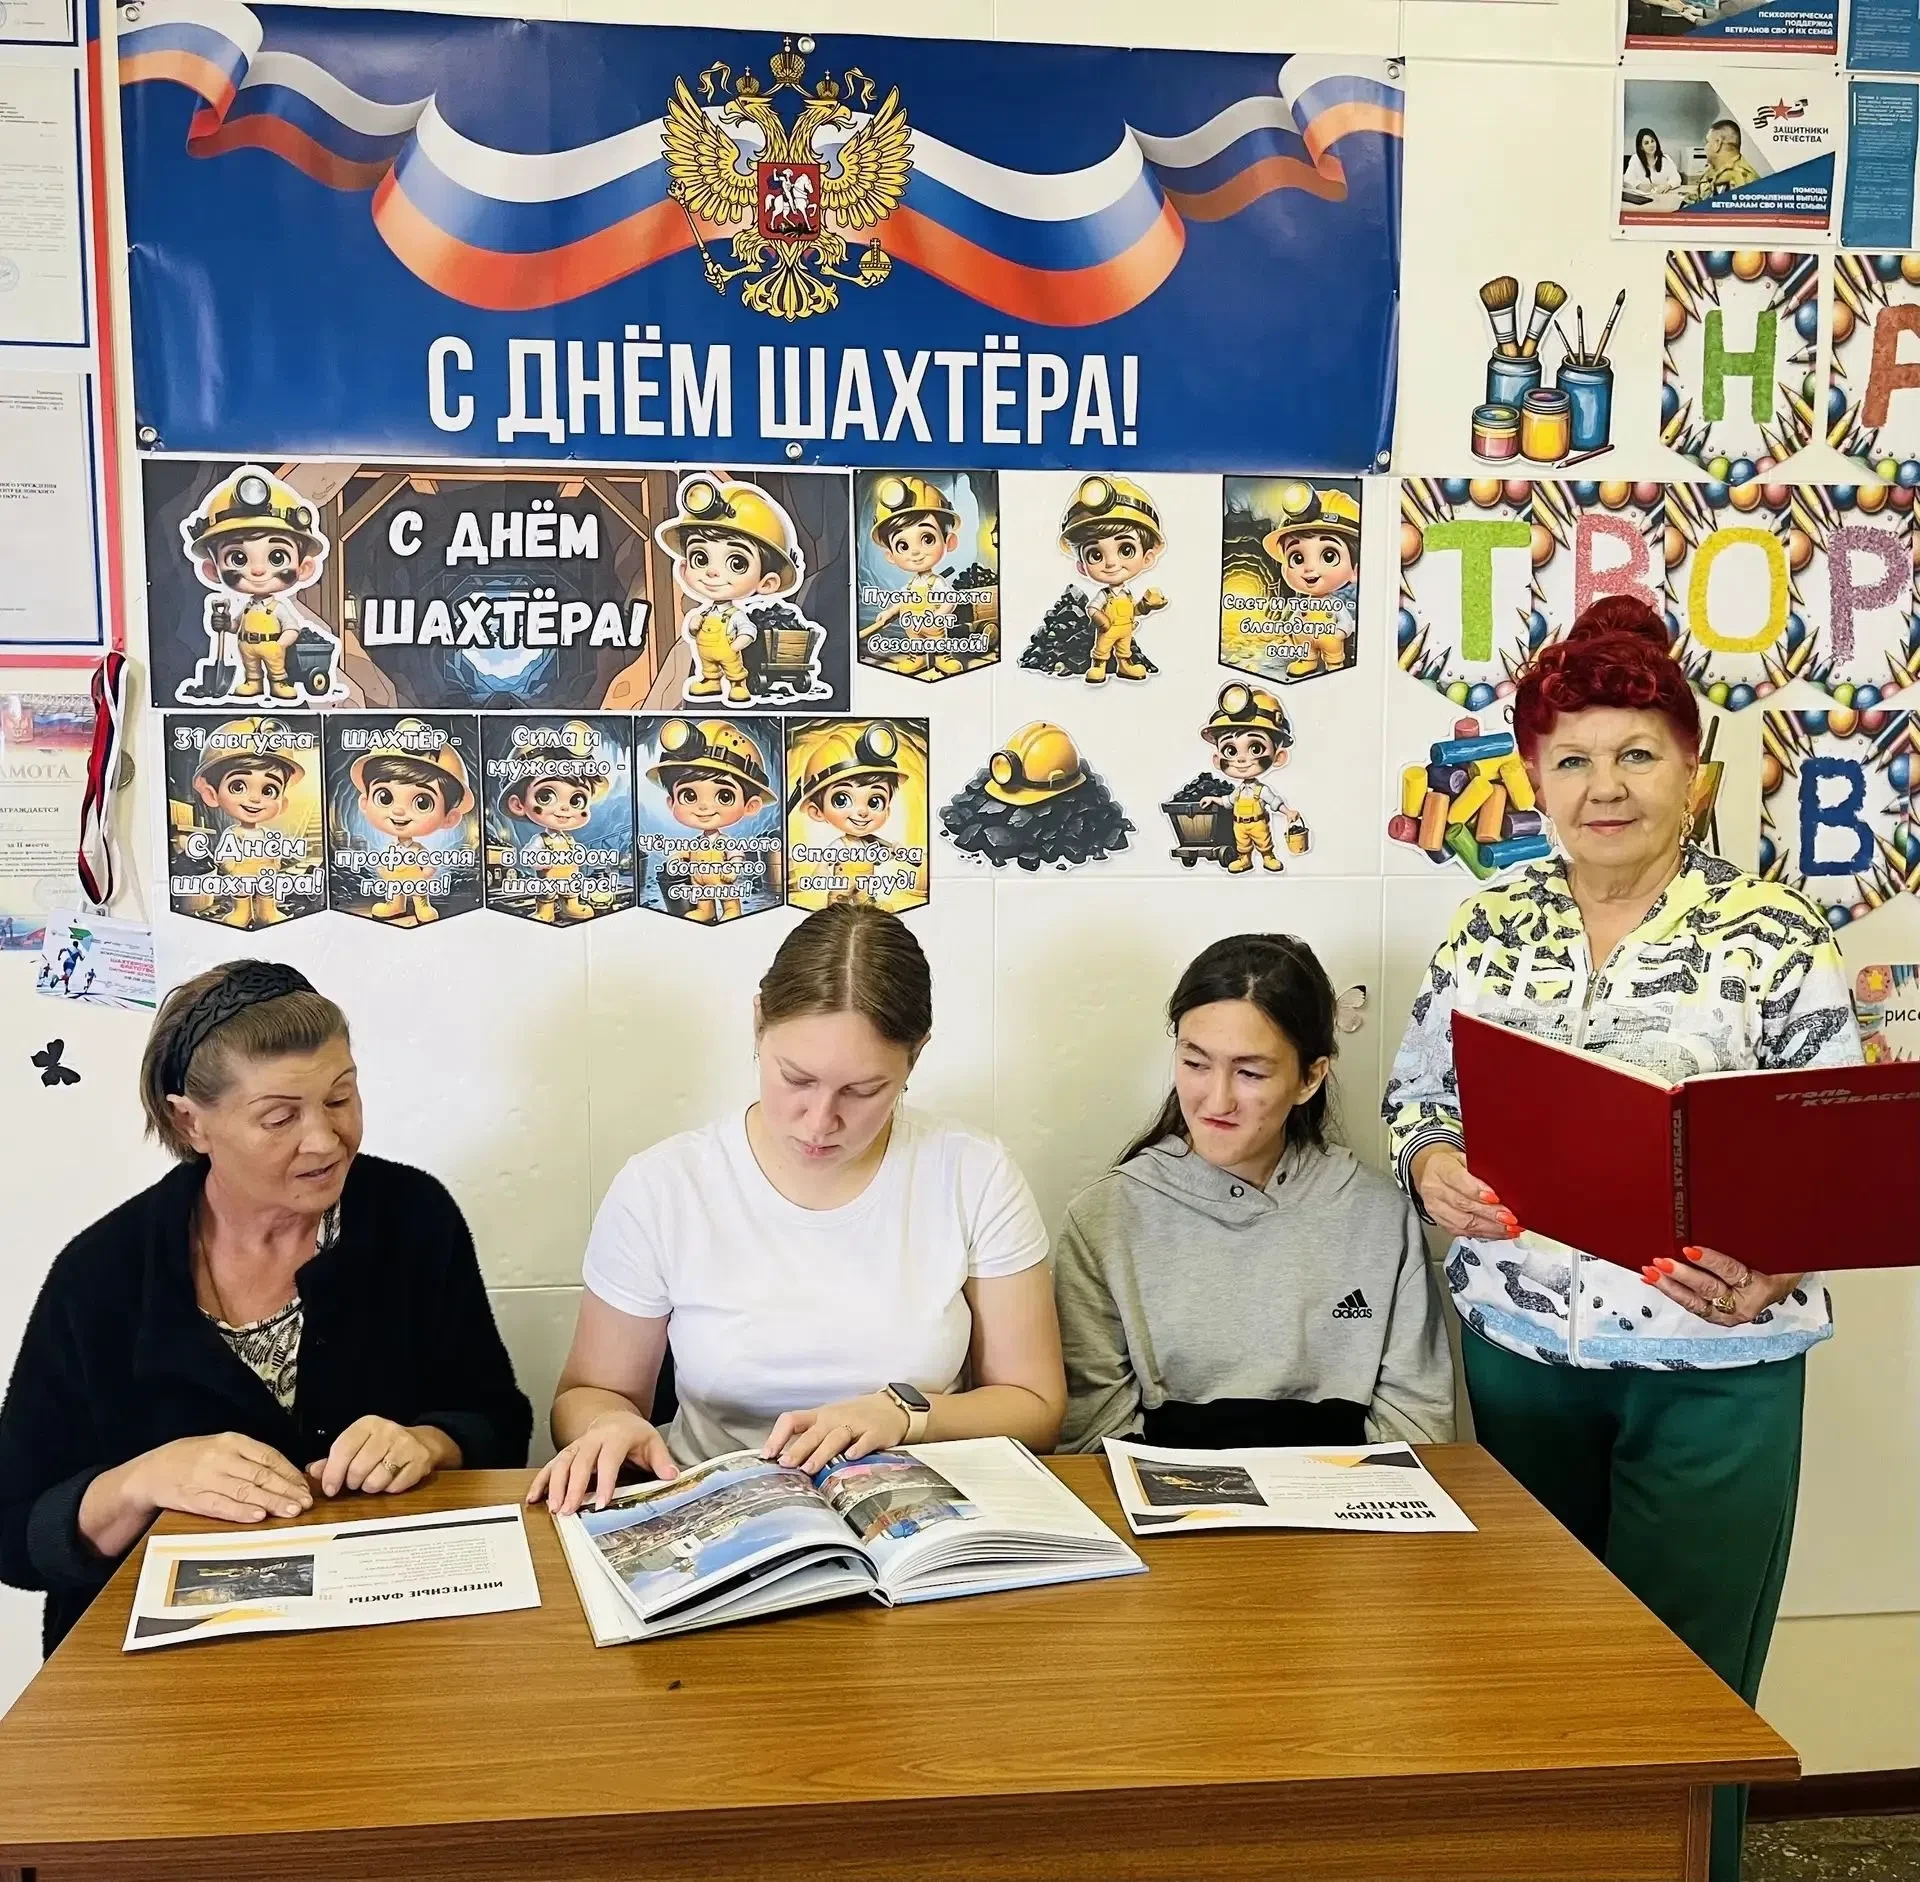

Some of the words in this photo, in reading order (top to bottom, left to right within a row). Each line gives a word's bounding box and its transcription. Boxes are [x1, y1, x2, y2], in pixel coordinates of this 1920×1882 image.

[1758, 11, 1833, 20] ПСИХОЛОГИЧЕСКАЯ
[1785, 20, 1833, 28] ПОДДЕРЖКА
[1772, 135, 1823, 143] ОТЕЧЕСТВА
[1773, 126, 1829, 134] ЗАЩИТНИКИ
[428, 335, 474, 433] С
[497, 324, 732, 443] ДНЁМ
[758, 335, 1139, 447] ШАХТЁРА!
[388, 510, 424, 557] С
[446, 499, 599, 566] ДНЁМ
[863, 588, 922, 608] Пусть
[927, 591, 992, 604] шахта
[1223, 594, 1267, 610] Свет
[1271, 598, 1284, 610] и
[1289, 598, 1343, 611] тепло
[363, 587, 651, 647] ШАХТЁРА!
[900, 610, 957, 632] будет
[1240, 617, 1337, 639] благодаря
[868, 635, 989, 653] безопасной!
[1266, 642, 1310, 659] вам!
[174, 729, 203, 750] 31
[210, 732, 314, 757] августа
[342, 726, 447, 751] ШАХТЁР
[511, 726, 576, 748] Сила
[583, 731, 601, 747] и
[487, 759, 611, 782] мужество
[187, 833, 210, 858] С
[216, 831, 307, 862] Днём
[501, 850, 514, 866] в
[522, 844, 619, 866] каждом
[637, 834, 710, 856] Чёрное
[714, 837, 782, 851] золото
[791, 844, 890, 863] Спасибо
[895, 848, 923, 863] за
[335, 846, 474, 873] профессия
[667, 859, 766, 875] богатство
[172, 869, 325, 902] шахтёра!
[361, 874, 451, 900] героев!
[503, 873, 619, 900] шахтёре!
[668, 882, 751, 904] страны!
[799, 874, 848, 891] ваш
[856, 871, 917, 897] труд!
[1884, 1009, 1920, 1027] рис
[1775, 1088, 1852, 1101] УГОЛЬ
[1801, 1091, 1920, 1107] КУЗБАССА
[1672, 1108, 1683, 1187] КУЗБАССА
[1332, 1306, 1373, 1319] adidas
[1334, 1510, 1397, 1521] ТАКОЙ
[1399, 1510, 1437, 1520] КТО
[348, 1591, 404, 1605] ФАКТЫ
[408, 1580, 504, 1598] ИНТЕРЕСНЫЕ
